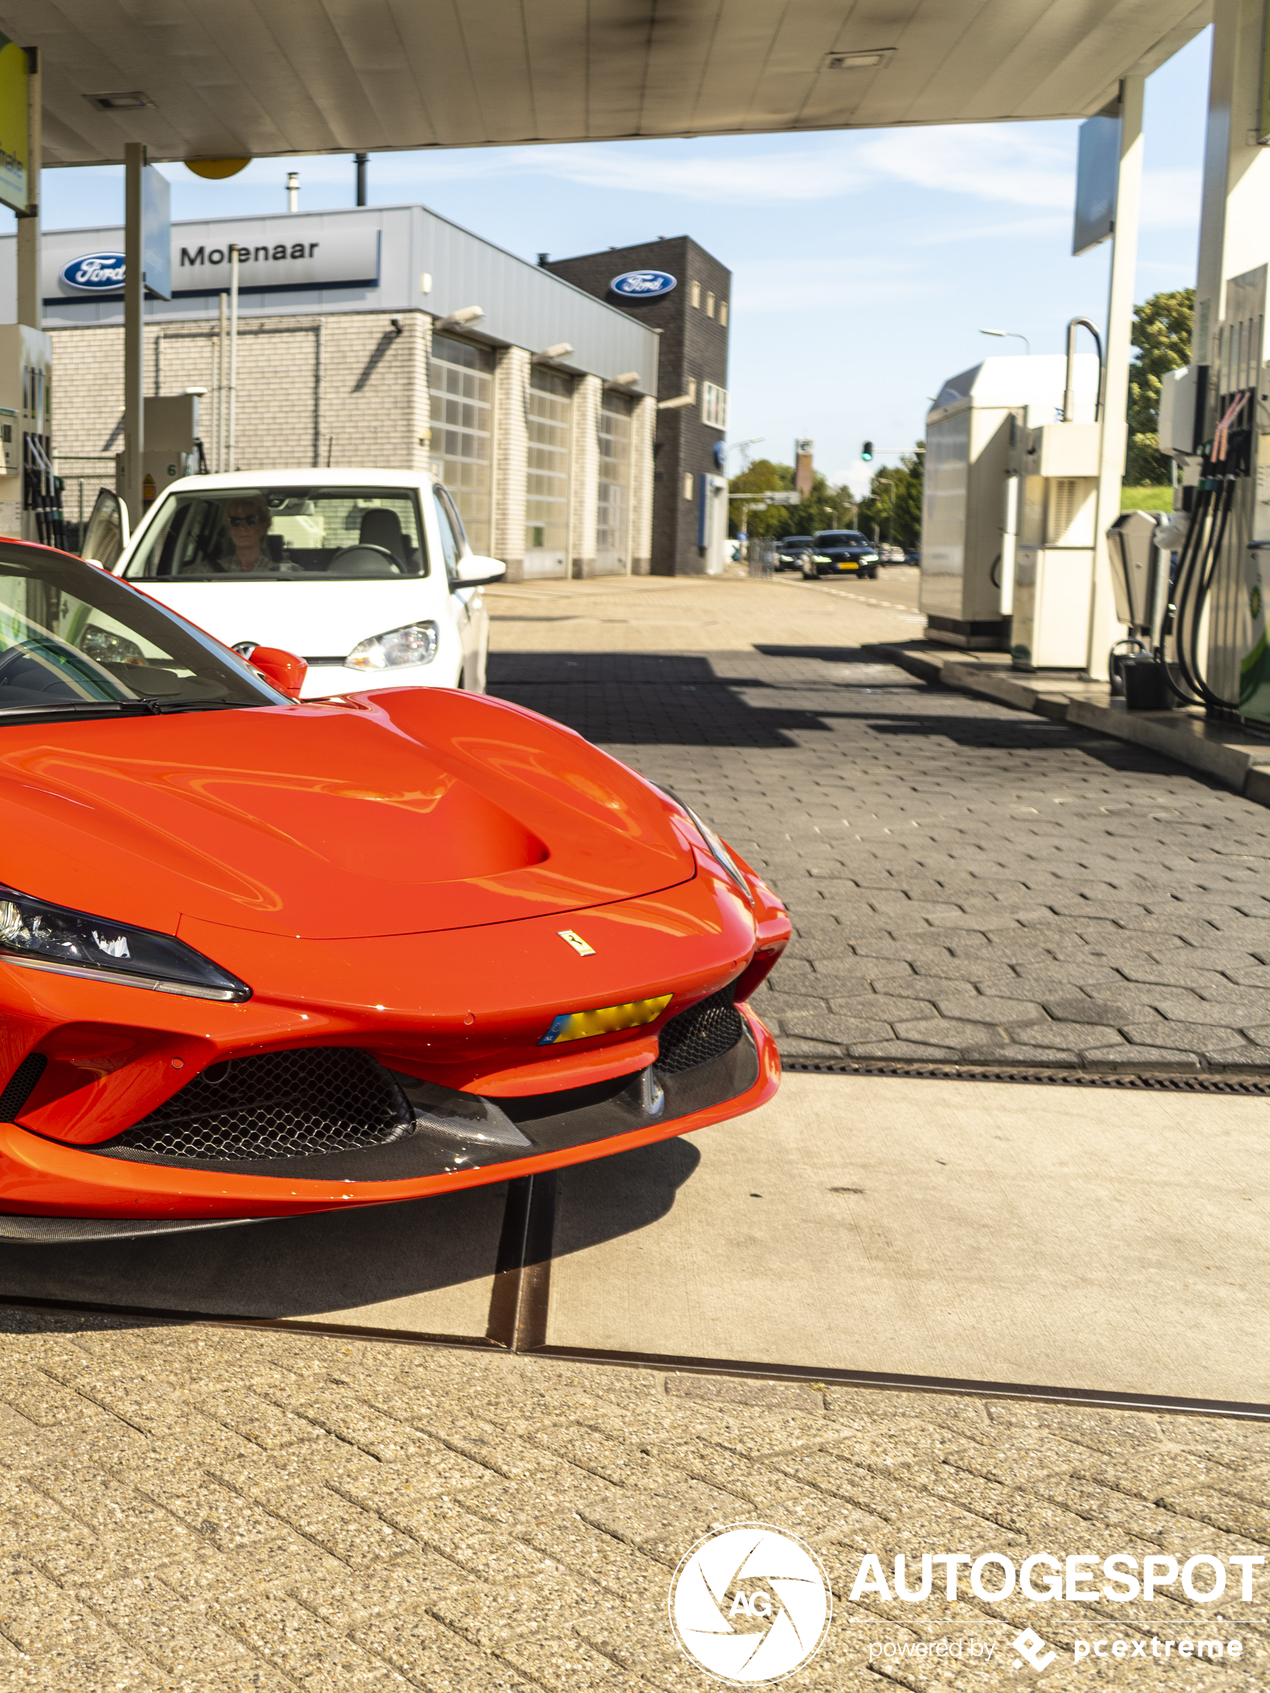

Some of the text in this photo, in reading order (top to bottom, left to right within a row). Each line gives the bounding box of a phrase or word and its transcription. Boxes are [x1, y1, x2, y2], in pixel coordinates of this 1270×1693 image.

[75, 258, 126, 283] Ford
[180, 242, 319, 267] Molenaar
[623, 274, 664, 292] Ford
[167, 464, 177, 477] 6
